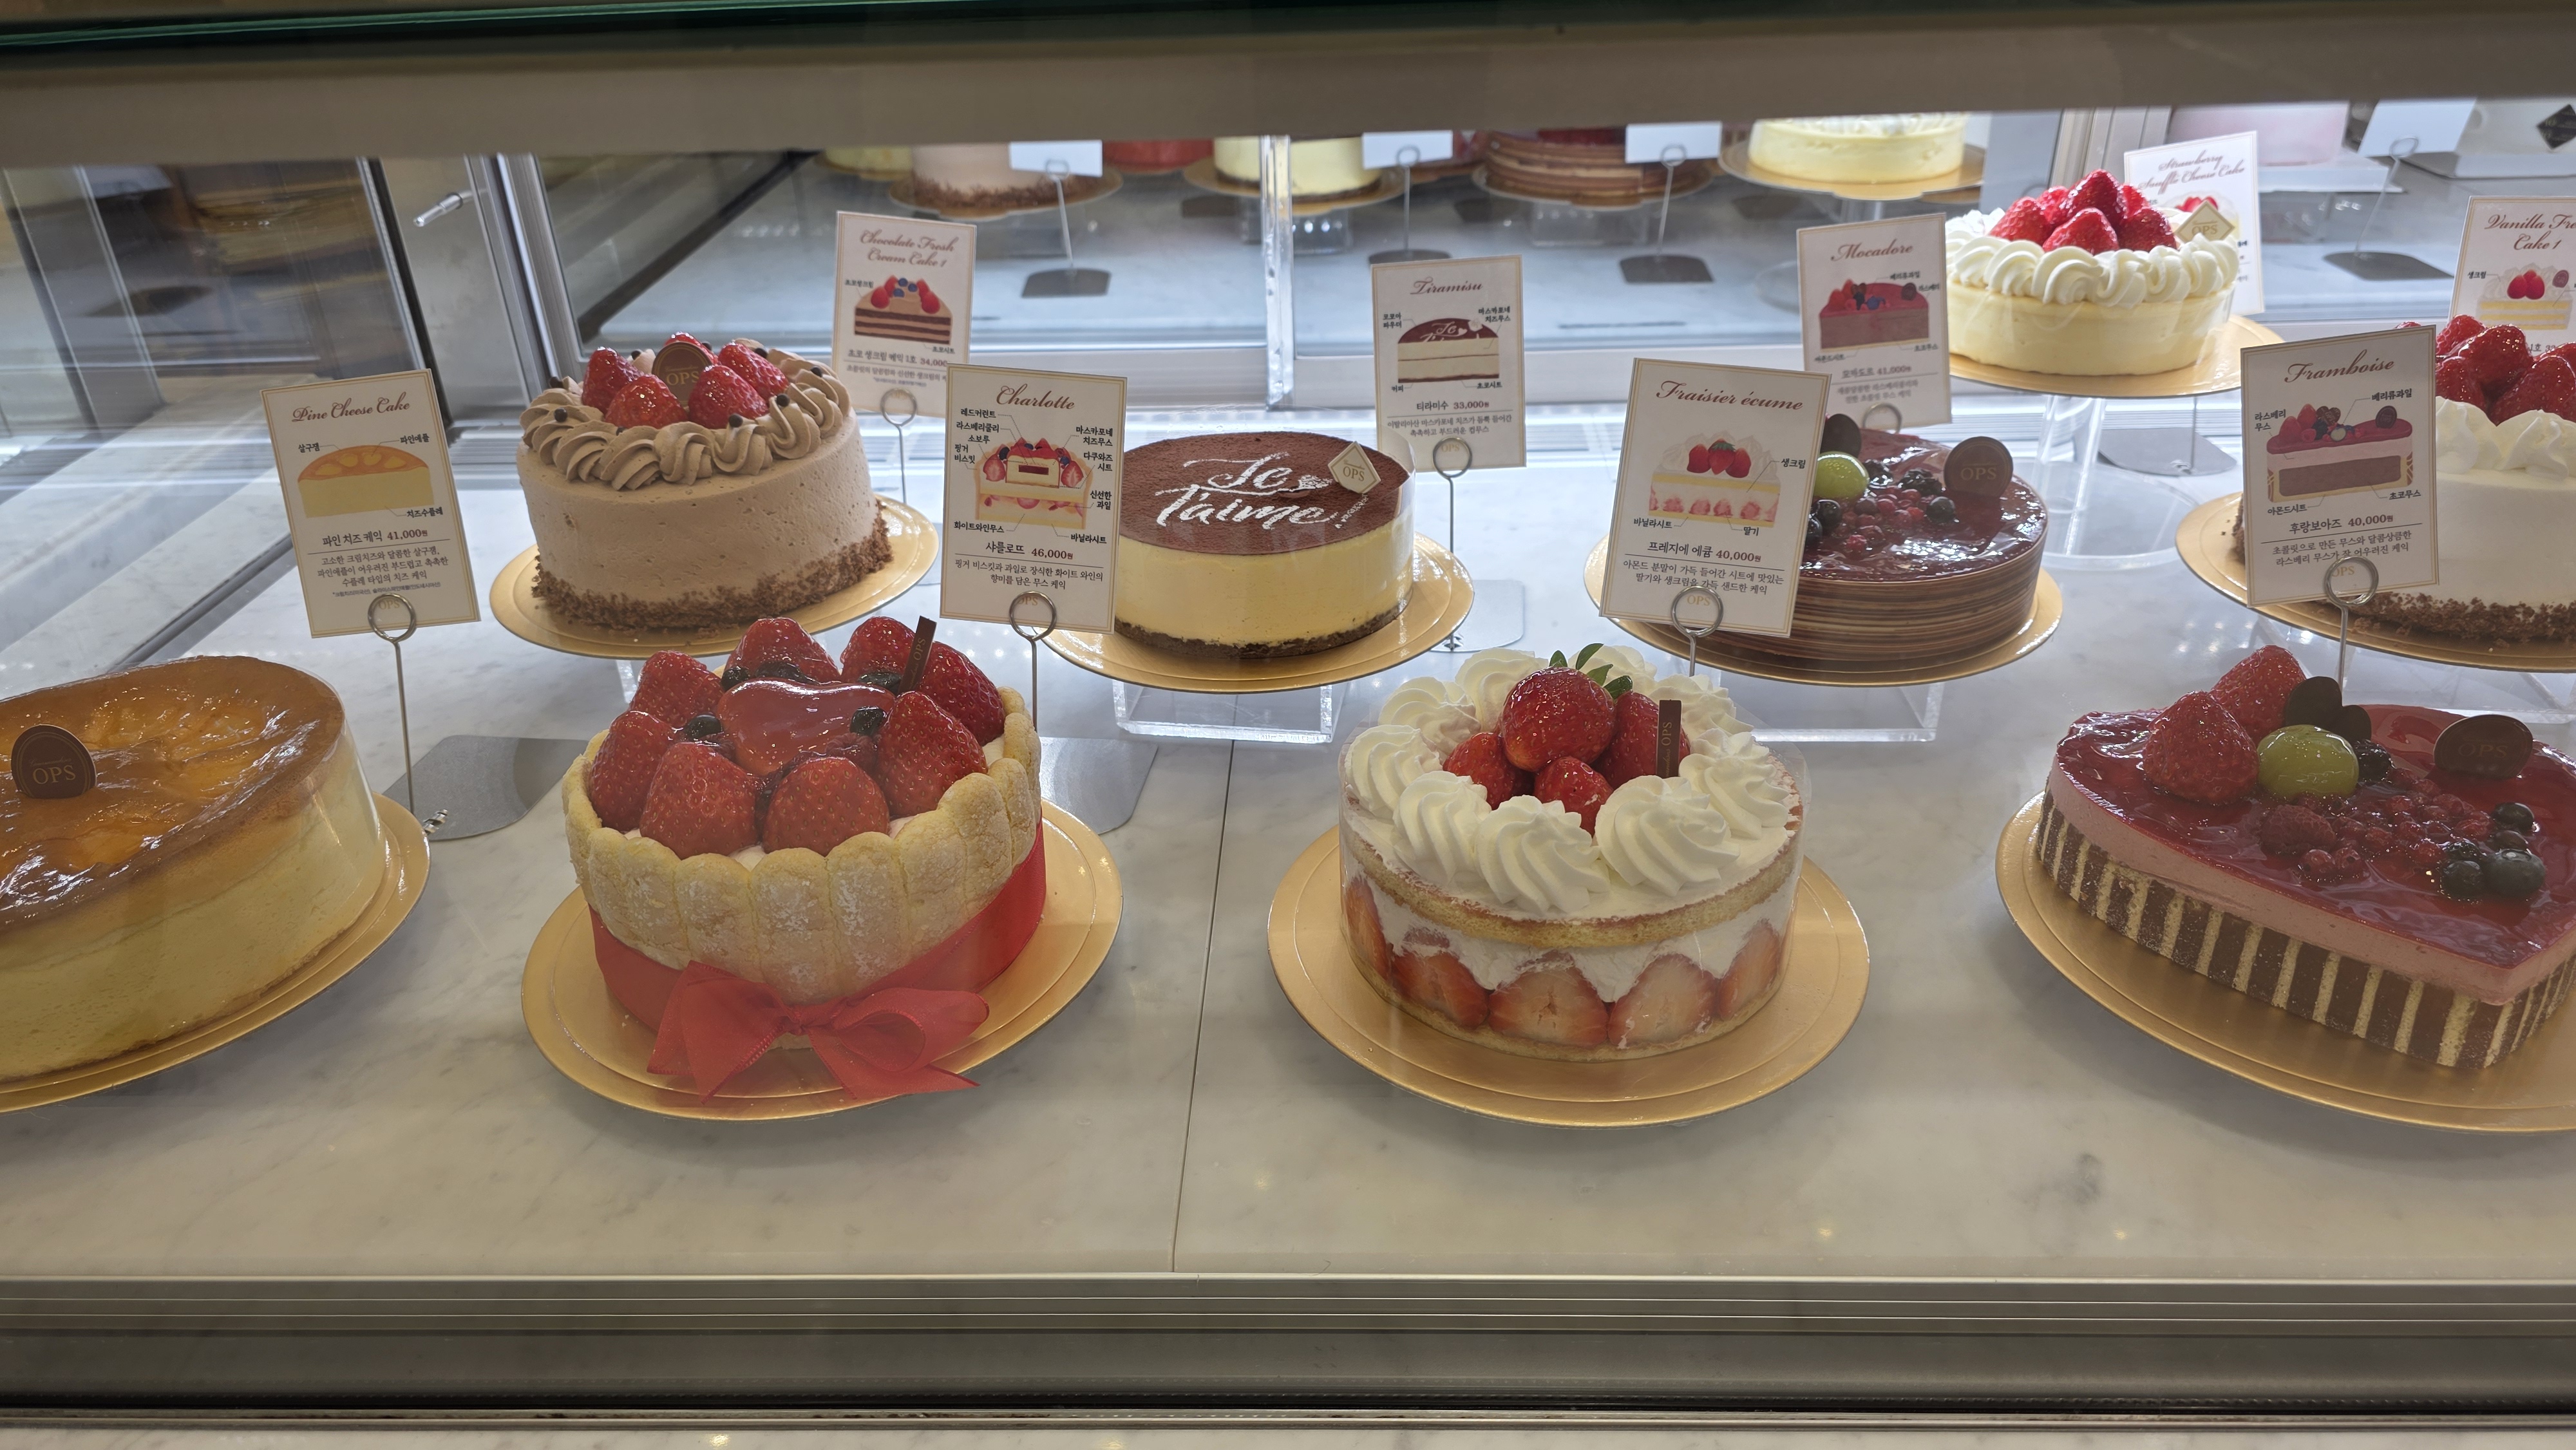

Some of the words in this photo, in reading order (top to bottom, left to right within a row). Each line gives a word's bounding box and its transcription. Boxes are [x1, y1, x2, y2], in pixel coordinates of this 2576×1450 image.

[2159, 149, 2224, 171] Strawberry
[2218, 159, 2245, 177] Cake
[2485, 214, 2544, 229] Vanilla
[860, 229, 914, 247] Chocolate
[916, 236, 959, 252] Fresh
[2514, 231, 2552, 250] Cake
[867, 245, 905, 263] Cream
[909, 251, 938, 267] Cake
[1830, 238, 1913, 261] Mocadore
[1410, 278, 1482, 294] Tiramisu
[2284, 349, 2394, 382] Framboise
[667, 371, 699, 385] OPS
[996, 384, 1074, 409] Charlotte
[1656, 381, 1736, 404] Fraisier
[1741, 391, 1803, 410] écume
[2372, 388, 2412, 401] 베리류과일
[292, 406, 327, 422] Pine
[331, 398, 373, 418] Cheese
[377, 391, 410, 413] Cake
[1417, 400, 1448, 411] 티라미수
[1454, 401, 1489, 410] 33,000원
[961, 408, 996, 419] 레드커런트
[2255, 409, 2286, 421] 라스베리
[956, 421, 999, 433] 라스베리쿨리
[1388, 419, 1420, 428] 이탈리아산
[1456, 416, 1475, 425] 치즈가
[1492, 415, 1511, 423] 들어간
[2255, 422, 2271, 431] 무스
[1076, 426, 1113, 437] 마스카포네
[1439, 427, 1466, 436] 부드러운
[400, 433, 430, 444] 파인애플
[968, 435, 990, 444] 소보루
[1083, 436, 1113, 446] 치즈무스
[298, 442, 319, 453] 살구잼
[955, 444, 968, 453] 핑거
[1441, 444, 1460, 452] OPS
[954, 454, 975, 464] 비스킷
[1084, 451, 1113, 461] 다쿠와즈
[1098, 463, 1112, 471] 시트
[1781, 458, 1806, 469] 생크림
[1343, 466, 1364, 482] OPS
[1960, 467, 1996, 480] OPS
[1090, 490, 1112, 500] 신선한
[2389, 490, 2421, 500] 초코무스
[1097, 501, 1111, 510] 과일
[2268, 504, 2307, 515] 아몬드시트
[407, 507, 443, 518] 치즈수플레
[954, 521, 1004, 532] 화이트와인무스
[1634, 518, 1672, 529] 바닐라시트
[2289, 519, 2342, 534] 후랑보아즈
[2348, 514, 2393, 527] 40,000원
[323, 534, 341, 547] 파인
[343, 534, 364, 545] 치즈
[363, 531, 382, 542] 케익
[388, 529, 428, 540] 41,000원
[1071, 533, 1106, 543] 바닐라시트
[1744, 527, 1759, 536] 딸기
[2273, 543, 2316, 554] 초콜릿으로
[2319, 540, 2336, 550] 만든
[2339, 536, 2365, 547] 무스와
[2368, 530, 2412, 544] 달콤상큼한
[322, 556, 345, 565] 고소한
[347, 551, 386, 563] 크림치즈와
[387, 549, 411, 559] 달콤한
[986, 541, 1025, 554] 샤를로뜨
[1032, 549, 1073, 560] 46,000원
[1647, 542, 1689, 555] 프레지에
[1716, 551, 1761, 562] 40,000원
[2276, 554, 2309, 567] 라스베리
[2313, 551, 2339, 562] 무스가
[2354, 545, 2389, 558] 어우러진
[2392, 542, 2408, 552] 케익
[317, 566, 355, 578] 파인애플이
[358, 563, 389, 574] 어우러진
[392, 560, 422, 570] 부드럽고
[425, 556, 448, 567] 촉촉한
[955, 559, 969, 569] 핑거
[973, 561, 1003, 572] 비스킷과
[1005, 564, 1027, 574] 과일로
[1030, 566, 1053, 576] 장식한
[1055, 569, 1078, 578] 화이트
[1080, 571, 1103, 581] 와인의
[1624, 560, 1648, 569] 아몬드
[1651, 563, 1676, 574] 분말이
[1680, 565, 1697, 576] 가득
[1700, 567, 1726, 578] 들어간
[1728, 570, 1754, 581] 시트에
[1758, 574, 1784, 584] 맛있는
[343, 576, 365, 587] 수플레
[368, 574, 391, 584] 타입의
[394, 573, 409, 581] 치즈
[412, 570, 427, 579] 케익
[990, 574, 1014, 585] 향미를
[1016, 576, 1031, 586] 담은
[1033, 578, 1048, 587] 무스
[1051, 580, 1065, 590] 케익
[1636, 573, 1662, 584] 딸기와
[1665, 576, 1697, 588] 생크림을
[1721, 582, 1748, 592] 샌드한
[1750, 585, 1767, 595] 케익
[379, 599, 400, 610] OPS
[1687, 595, 1710, 606] OPS
[914, 637, 926, 661] OPS
[1662, 722, 1672, 746] OPS
[2458, 743, 2508, 758] OPS
[33, 765, 76, 784] OPS
